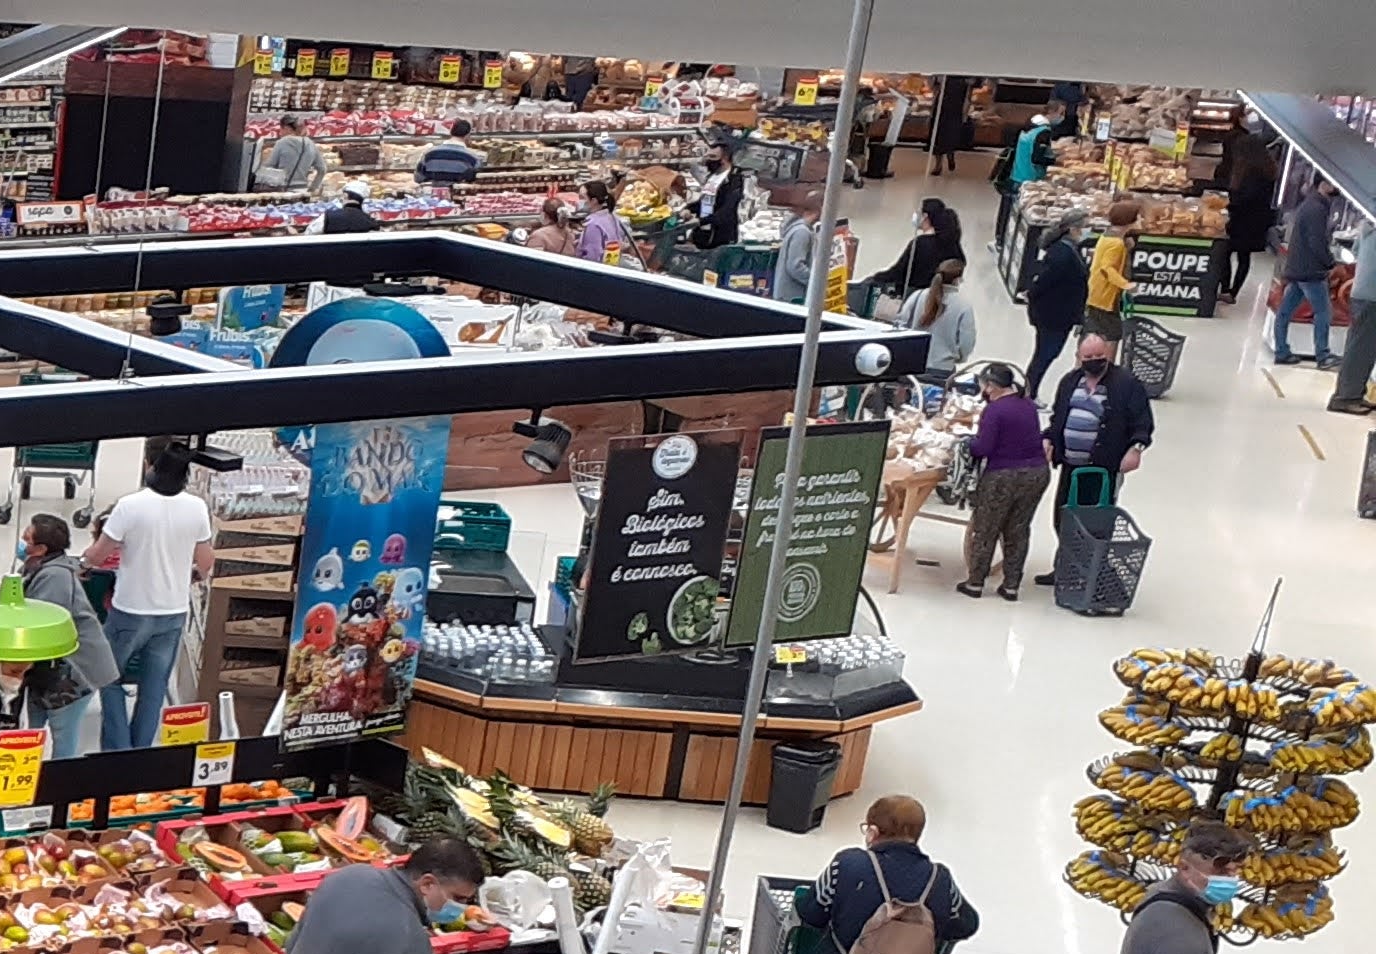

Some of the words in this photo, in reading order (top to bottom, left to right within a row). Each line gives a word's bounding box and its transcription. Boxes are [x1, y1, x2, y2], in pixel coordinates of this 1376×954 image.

[1133, 251, 1211, 273] POUPE
[1154, 271, 1182, 282] ESTA
[1136, 282, 1202, 300] EMANA
[197, 760, 229, 780] 3,89
[2, 774, 34, 791] 1,99
